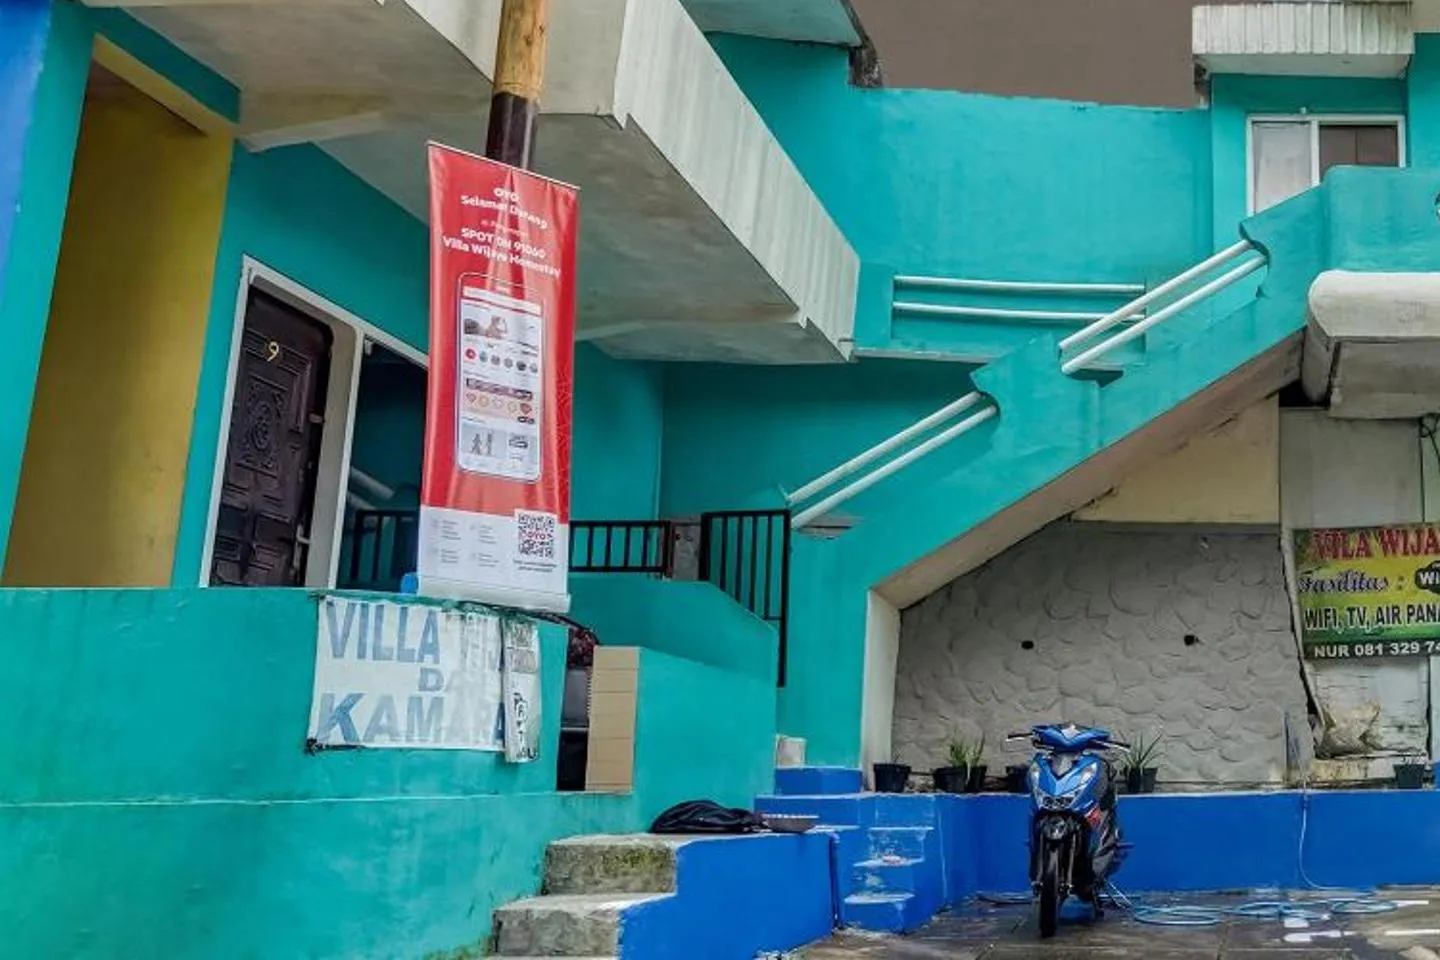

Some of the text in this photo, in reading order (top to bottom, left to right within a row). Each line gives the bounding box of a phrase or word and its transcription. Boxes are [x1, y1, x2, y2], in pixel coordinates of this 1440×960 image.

[1375, 605, 1401, 625] AIR
[326, 602, 440, 664] VILLA
[1315, 645, 1349, 658] NUR
[1355, 644, 1384, 656] 081
[1390, 642, 1420, 655] 329
